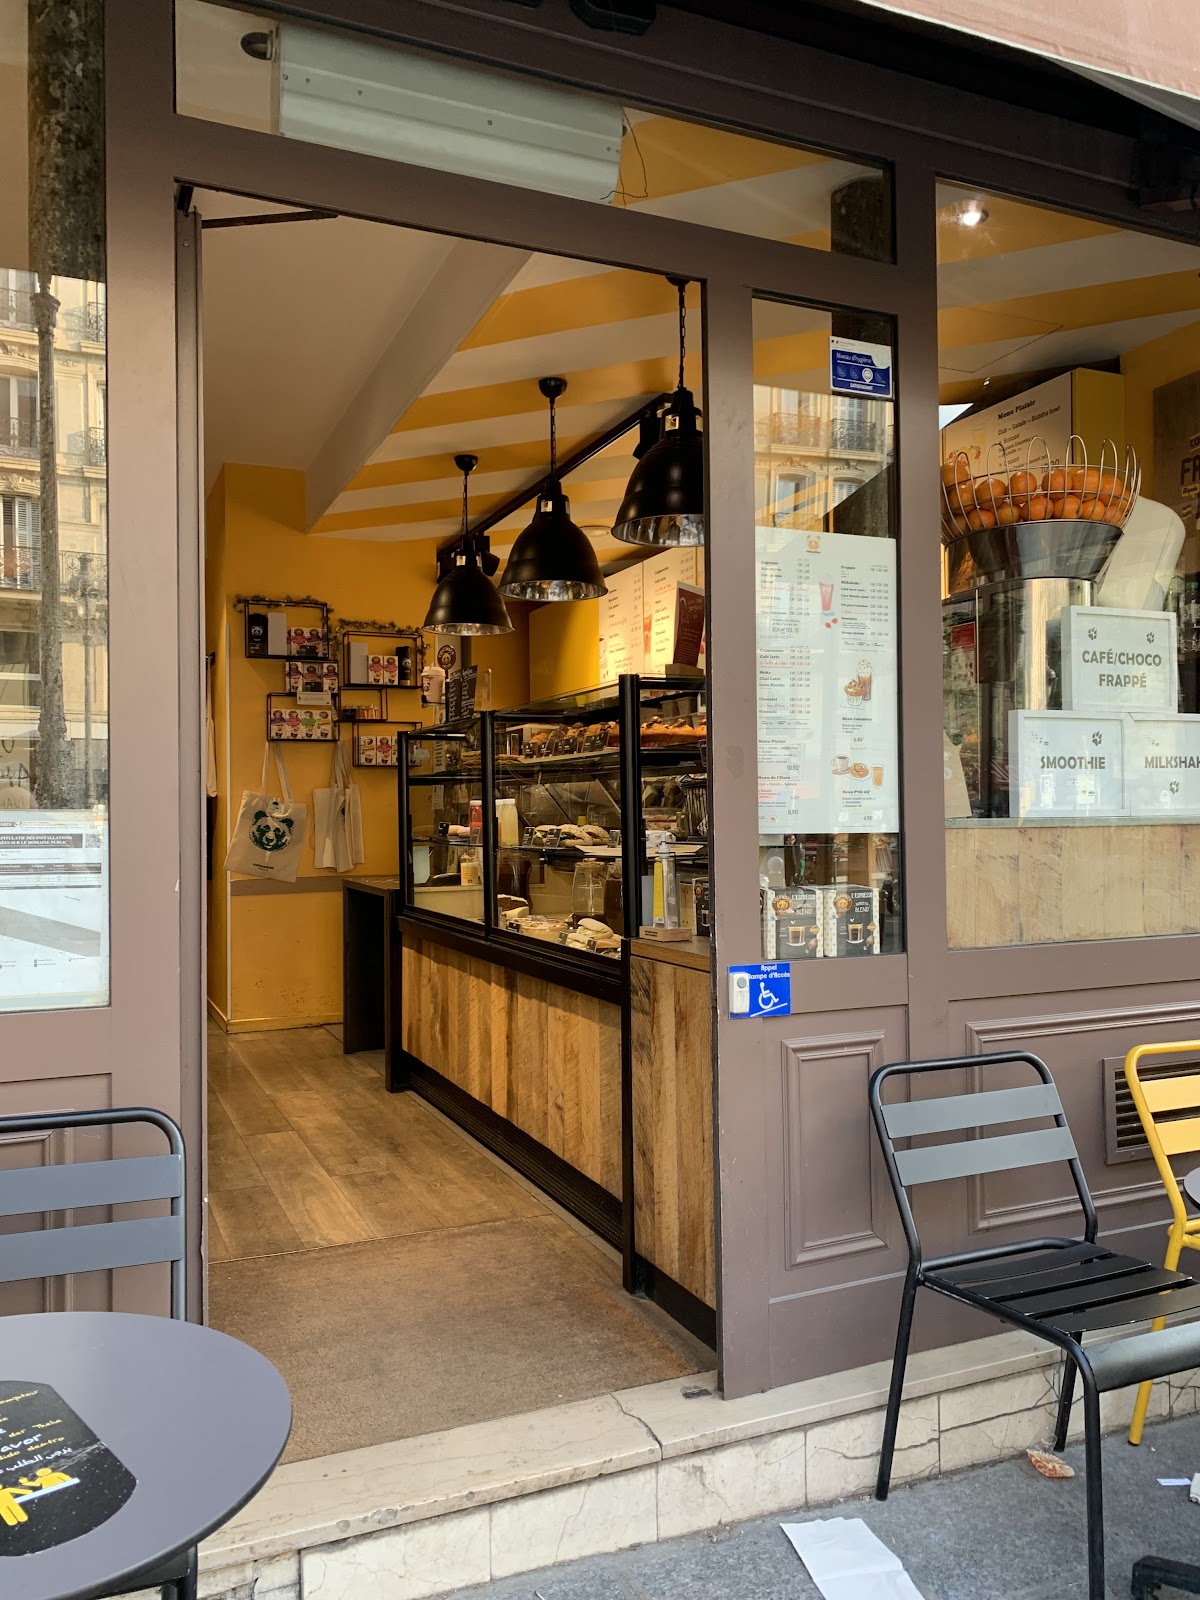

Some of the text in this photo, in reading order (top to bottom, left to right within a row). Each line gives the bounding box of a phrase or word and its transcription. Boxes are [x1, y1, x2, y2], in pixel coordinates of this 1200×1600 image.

[998, 401, 1036, 420] Menu Plaisir
[1081, 648, 1162, 667] CAFÉ/CHOCO
[1098, 672, 1147, 689] FRAPPÉ
[1040, 755, 1106, 770] SMOOTHIE
[760, 964, 778, 973] Appel
